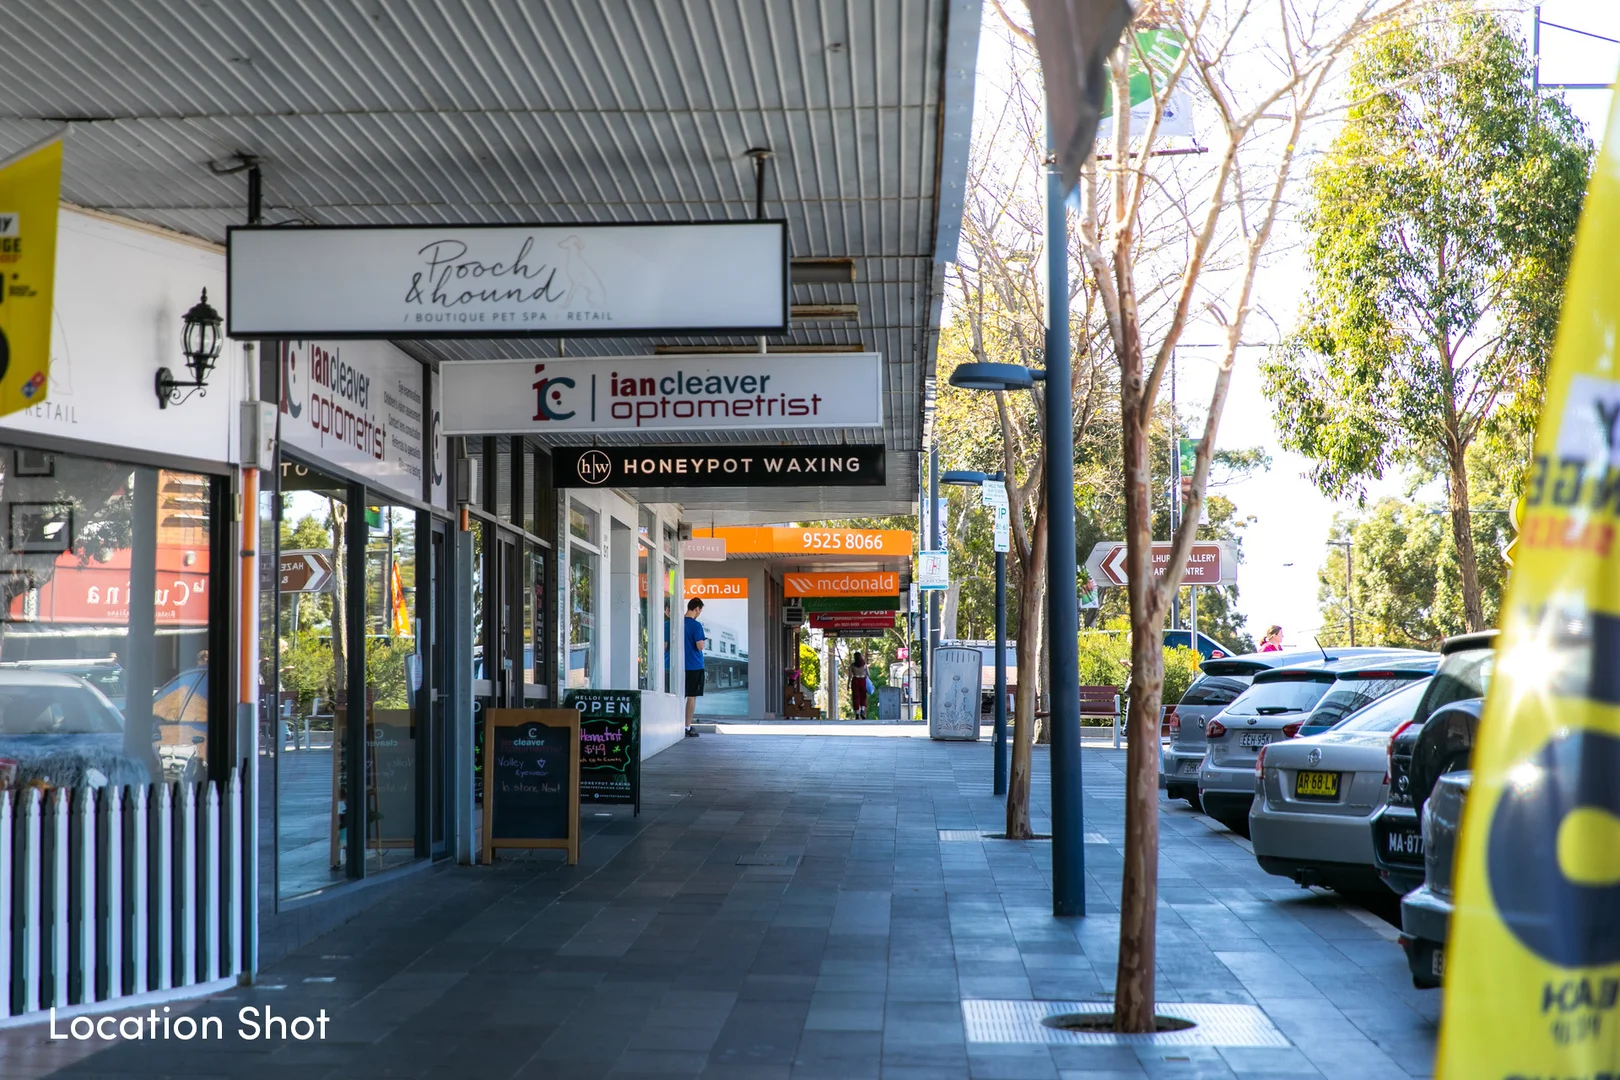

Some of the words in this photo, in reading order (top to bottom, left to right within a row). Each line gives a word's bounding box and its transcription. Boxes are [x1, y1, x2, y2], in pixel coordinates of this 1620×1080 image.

[418, 236, 547, 283] Pooch
[416, 312, 485, 323] BOUTIQUE
[493, 312, 516, 322] PET
[522, 312, 547, 321] SPA
[567, 311, 613, 321] RETAIL
[611, 393, 822, 427] optometrist
[311, 392, 387, 462] optometrist
[624, 458, 754, 475] HONEYPOT
[764, 456, 861, 473] WAXING
[802, 532, 841, 549] 9525
[845, 533, 883, 550] 8066
[1151, 554, 1171, 563] LHUR
[1187, 554, 1216, 562] ALLERY
[1185, 567, 1205, 576] NTRE
[817, 575, 893, 590] mcdonald
[575, 700, 630, 714] OPEN
[513, 738, 545, 746] cleaver
[584, 743, 606, 756] $49
[498, 756, 524, 769] Volley
[515, 769, 548, 778] Eyewear
